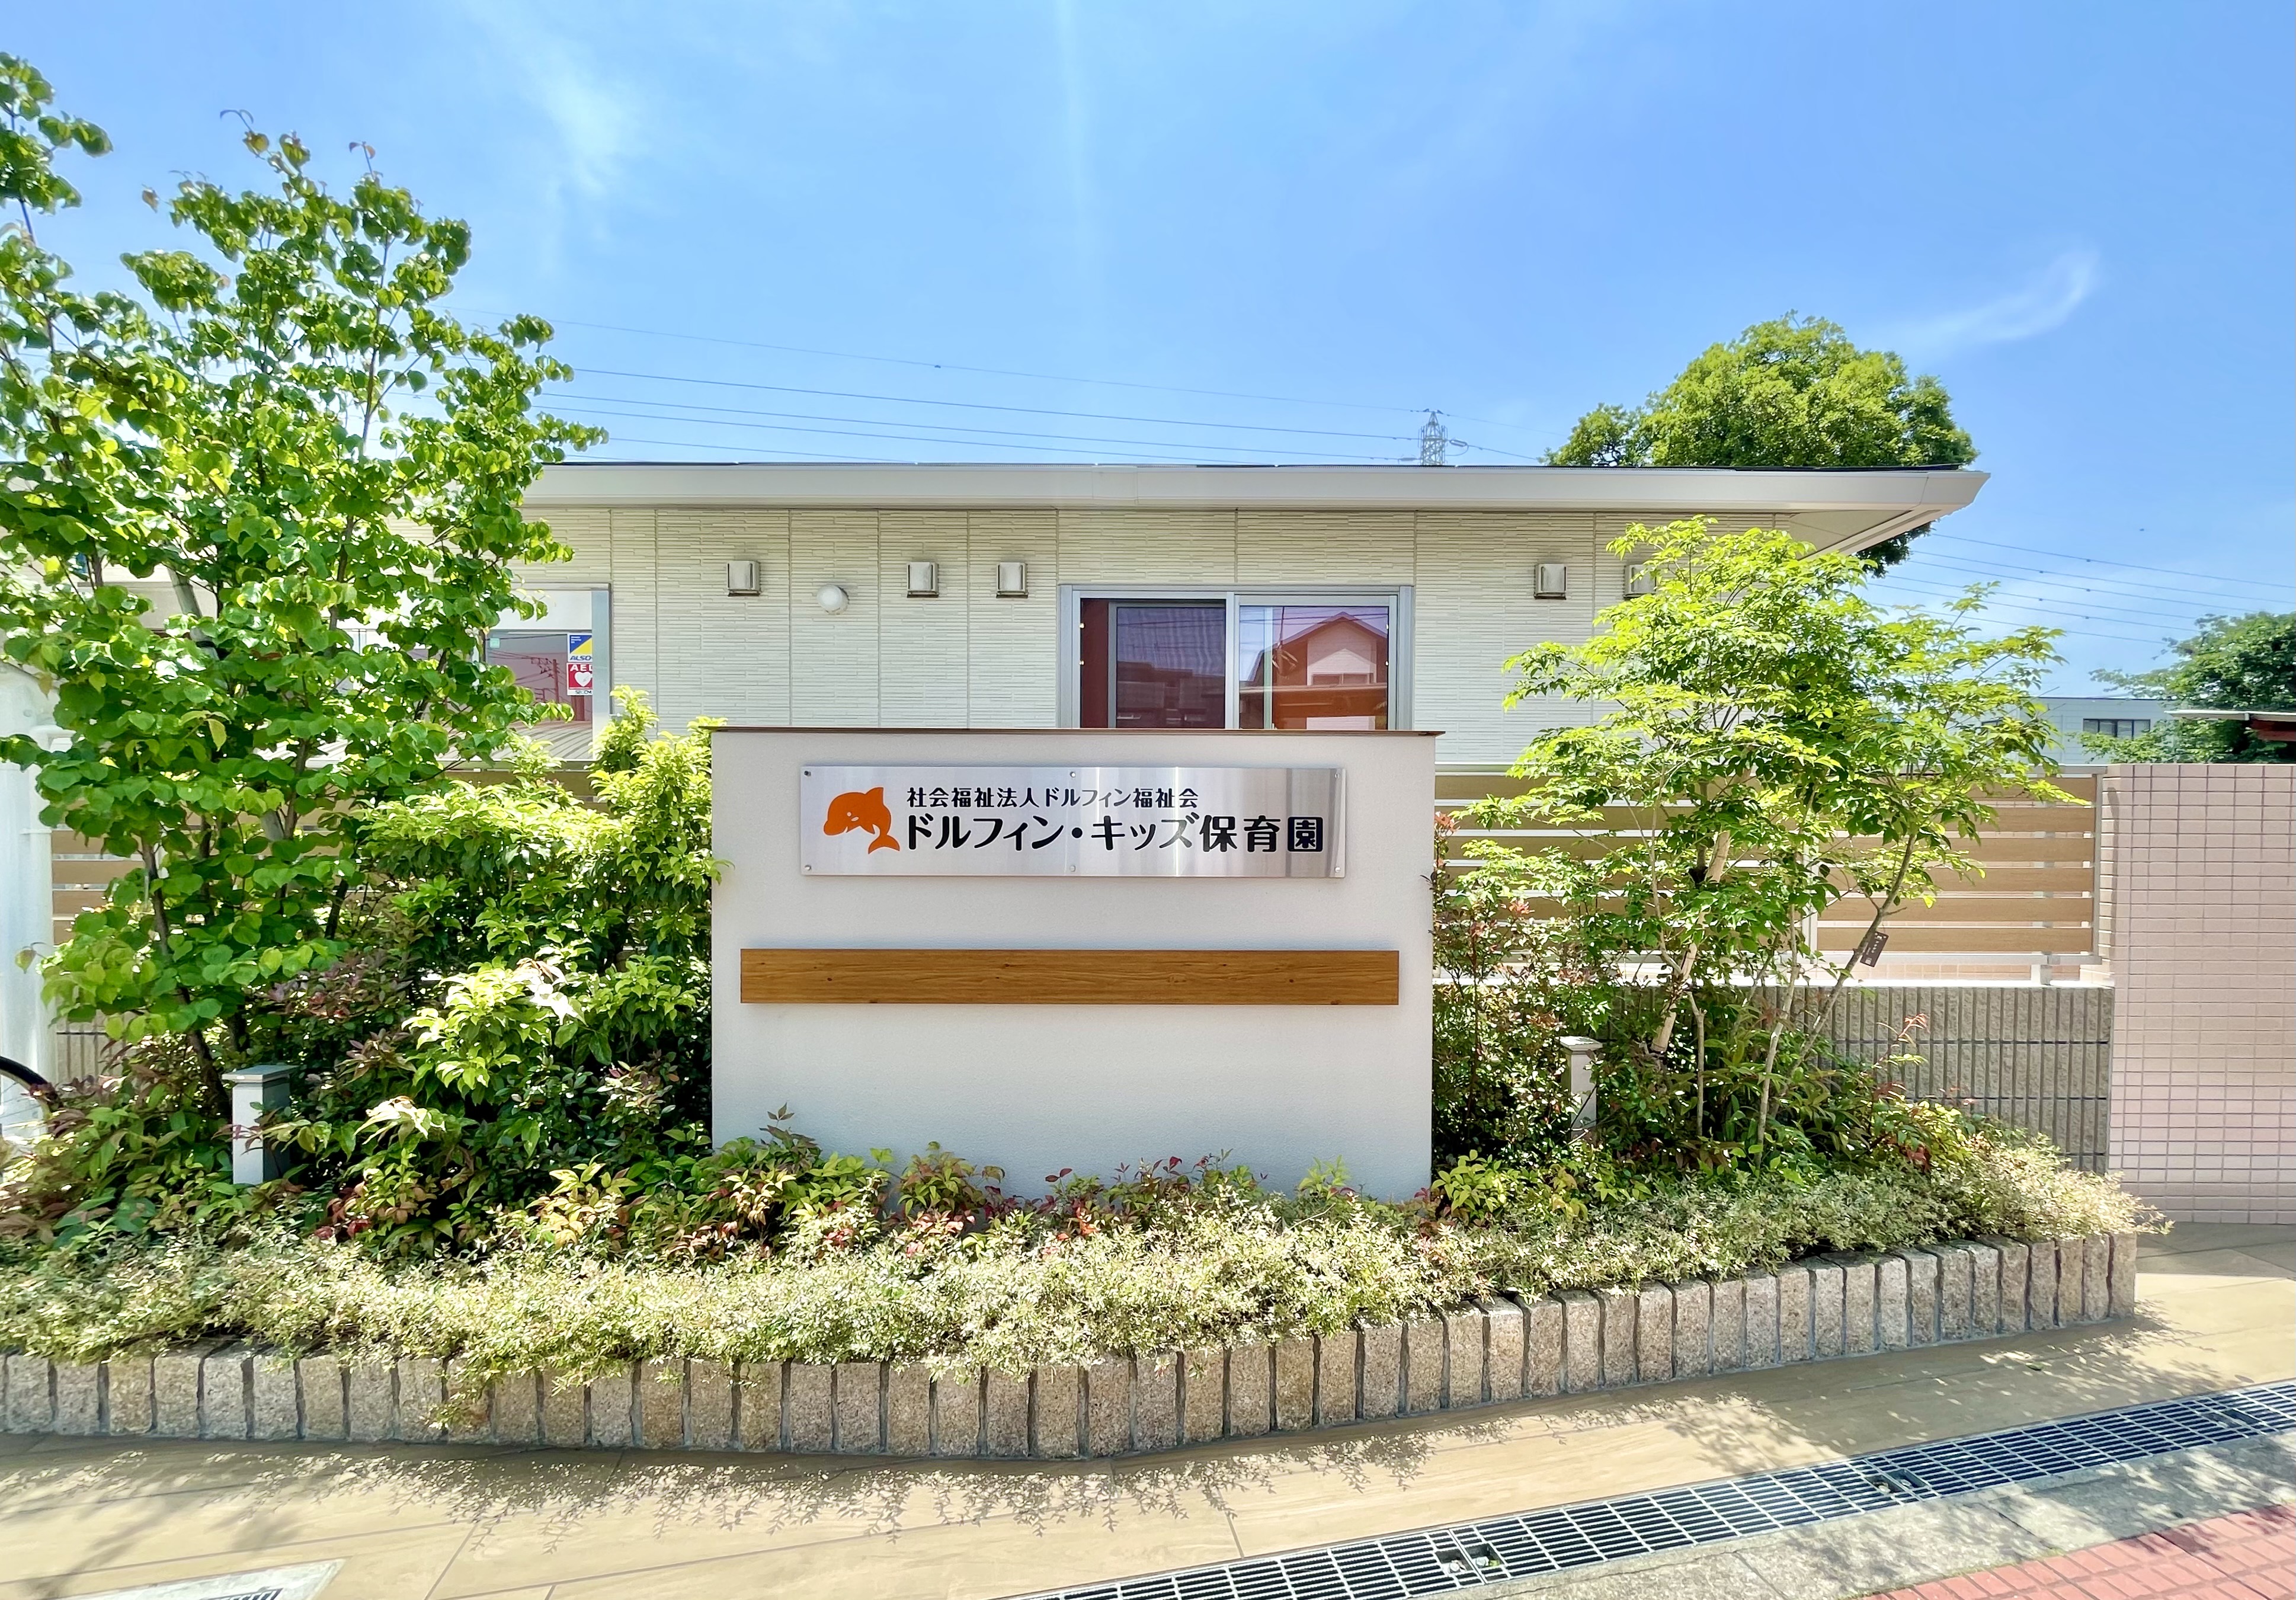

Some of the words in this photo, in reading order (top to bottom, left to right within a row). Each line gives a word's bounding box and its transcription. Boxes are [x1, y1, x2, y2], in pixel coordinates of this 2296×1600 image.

[907, 787, 1198, 808] 社会福祉法人ドルフィン福祉会
[908, 812, 1323, 852] ドルフィン・キッズ保育園
